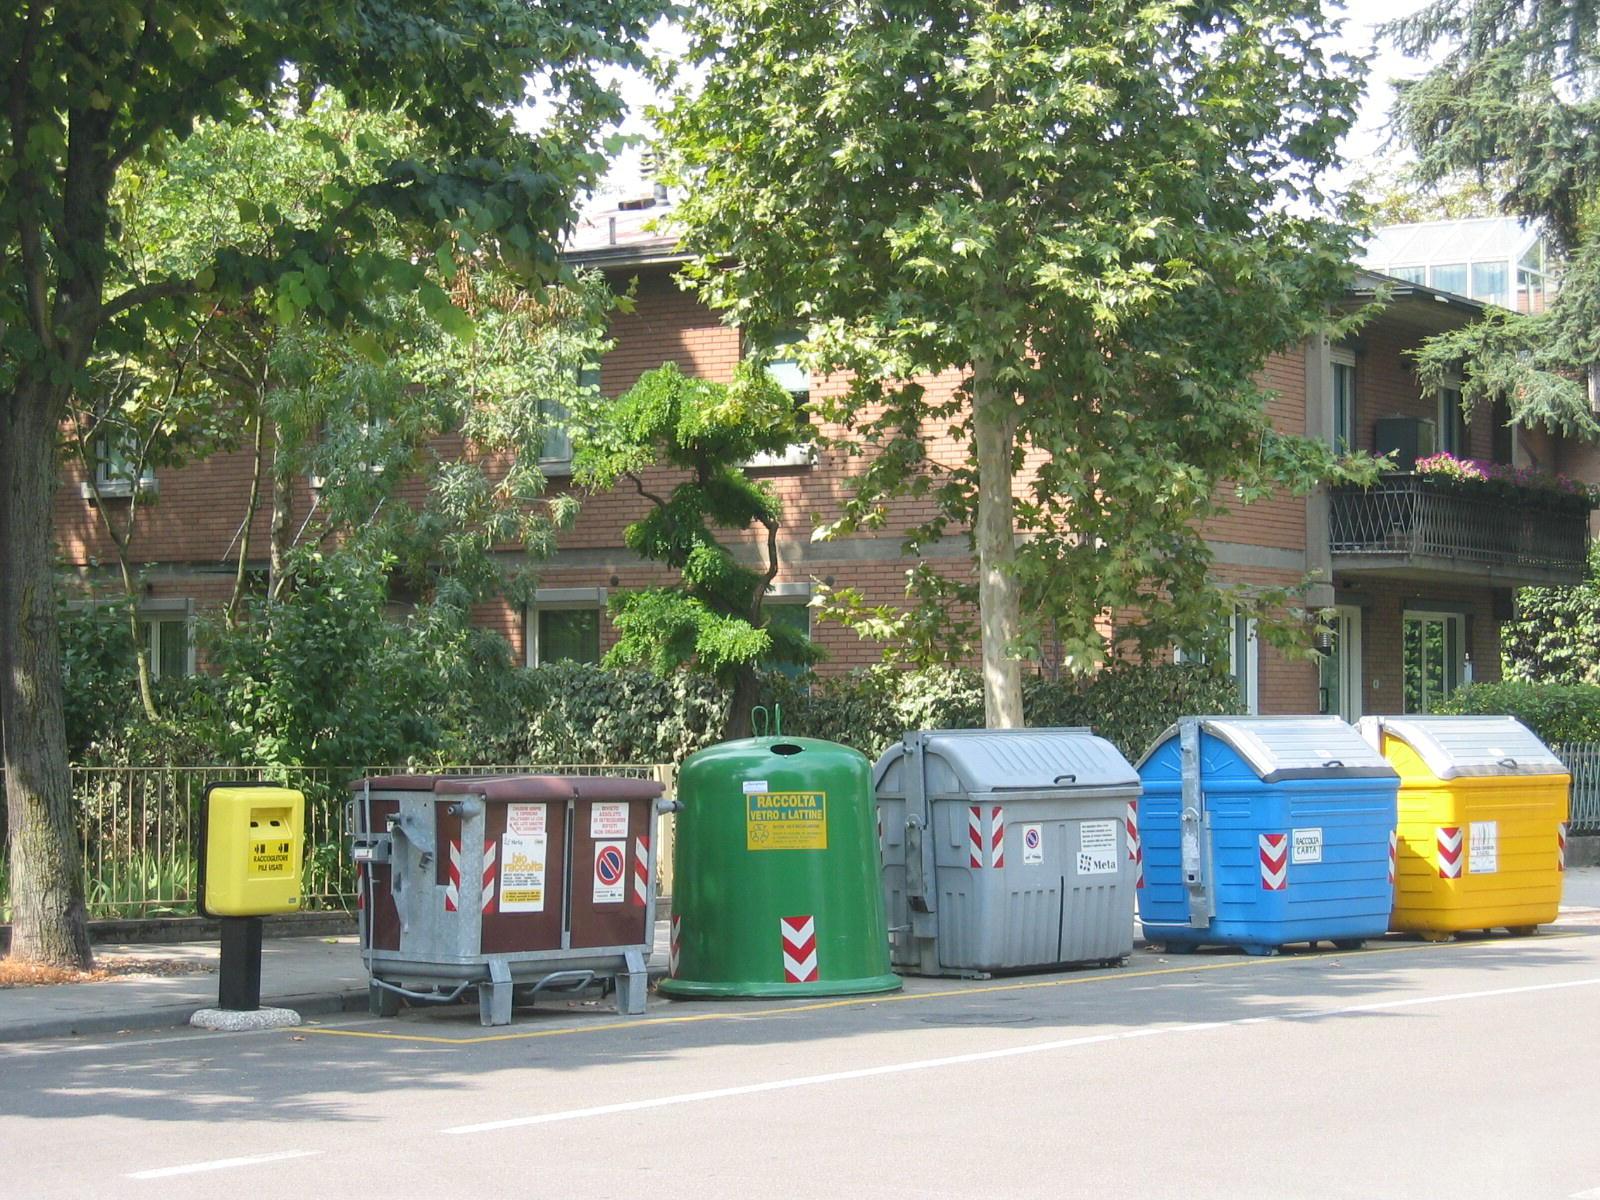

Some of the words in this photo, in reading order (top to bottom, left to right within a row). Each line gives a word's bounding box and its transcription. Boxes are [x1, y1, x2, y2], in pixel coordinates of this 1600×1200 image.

[757, 796, 816, 807] RACCOLTA
[751, 809, 779, 820] VETRO
[788, 809, 823, 820] LATTINE
[1296, 837, 1319, 845] RACCOLTA
[1297, 846, 1316, 854] CARTA
[512, 852, 528, 864] bio
[504, 860, 543, 872] raccolta
[1094, 861, 1116, 869] Meta
